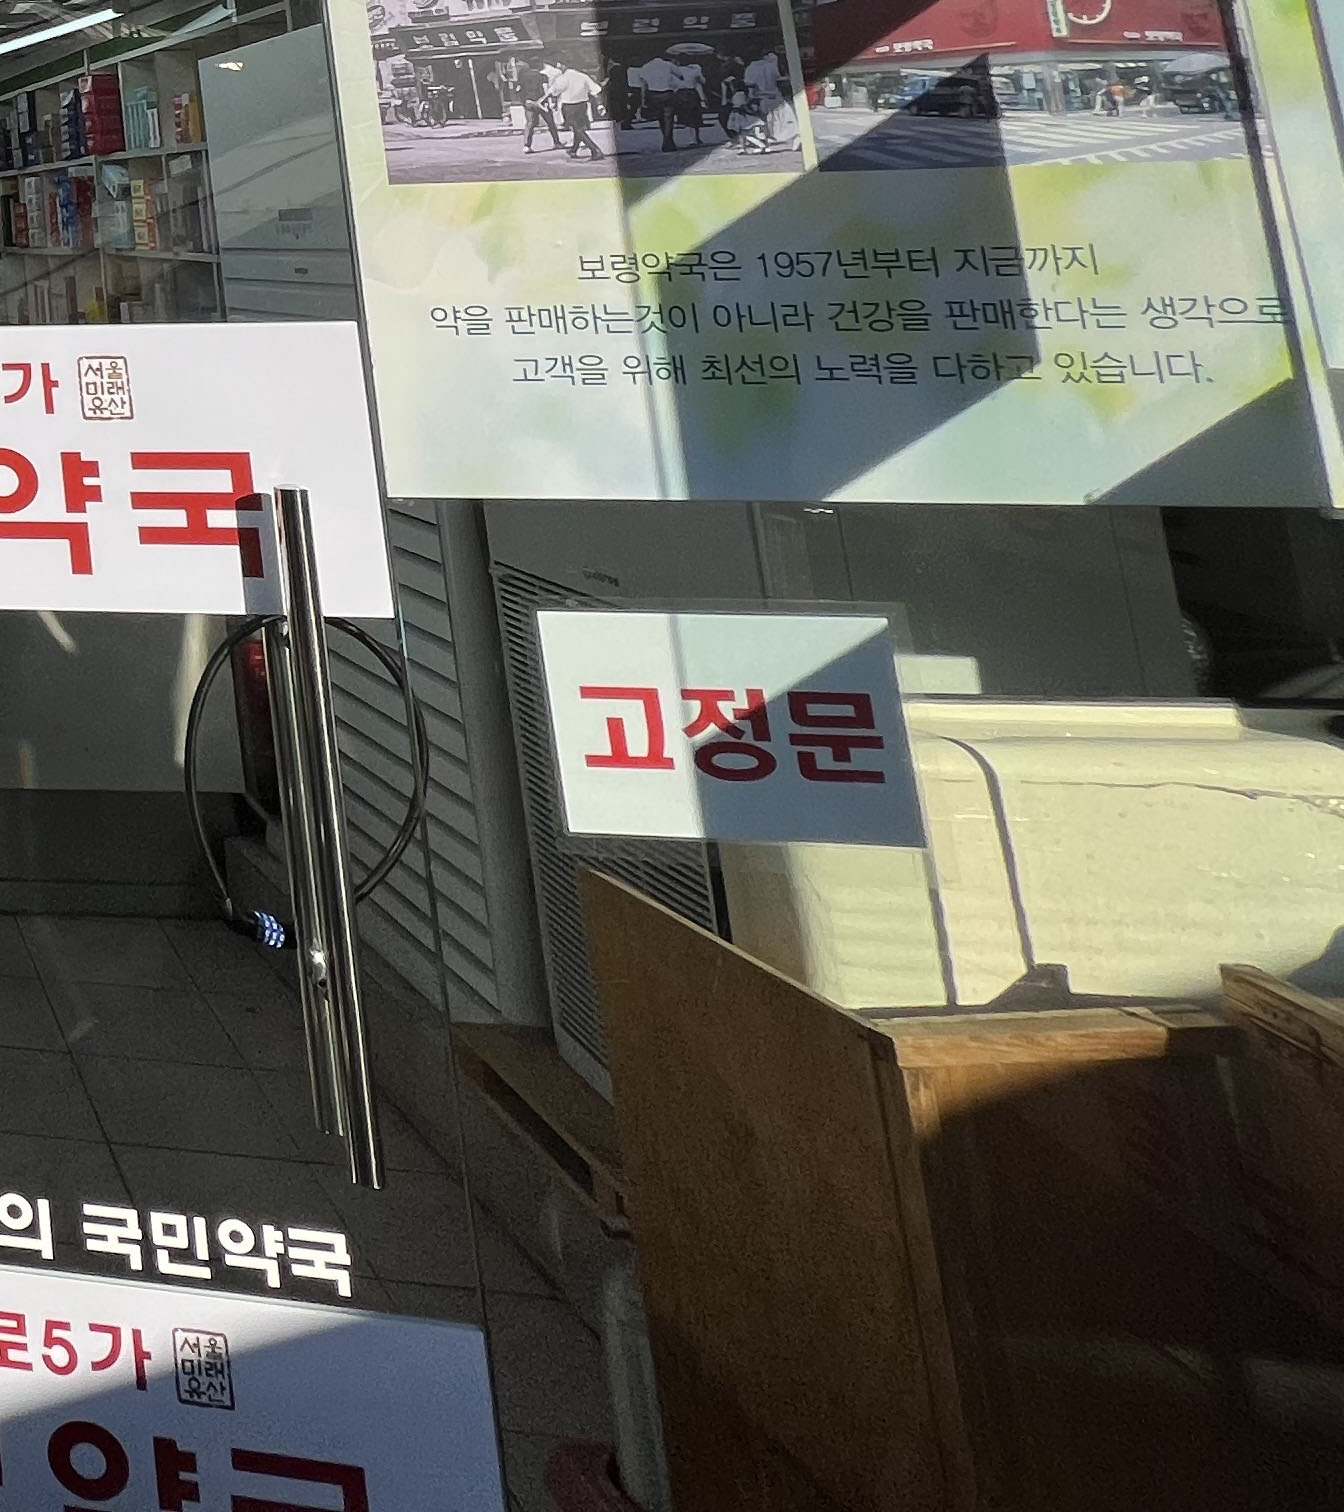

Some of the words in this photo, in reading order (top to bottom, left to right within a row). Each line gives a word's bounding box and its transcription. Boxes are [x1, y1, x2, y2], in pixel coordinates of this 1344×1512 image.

[577, 251, 743, 284] 보령약국은
[756, 247, 942, 282] 1957년부터
[953, 243, 1100, 280] 지금까지
[428, 303, 495, 339] 약을
[503, 301, 702, 338] 판매하는것이
[713, 299, 816, 336] 아니라
[826, 298, 934, 335] 건강을
[944, 297, 1130, 334] 판매한다는
[1139, 294, 1292, 330] 생각으로
[83, 360, 124, 378] 서울
[511, 351, 609, 389] 고객을
[620, 351, 689, 389] 위해
[700, 350, 804, 388] 최선의
[814, 350, 920, 388] 노력을
[930, 349, 1040, 387] 다하고
[1051, 348, 1218, 388] 있습니다.
[85, 379, 127, 397] 미래
[87, 397, 128, 416] 유산
[578, 685, 887, 785] 고정문
[81, 1202, 354, 1298] 국민약국
[178, 1334, 224, 1357] 서울
[181, 1357, 226, 1380] 미래
[183, 1378, 229, 1402] 유산
